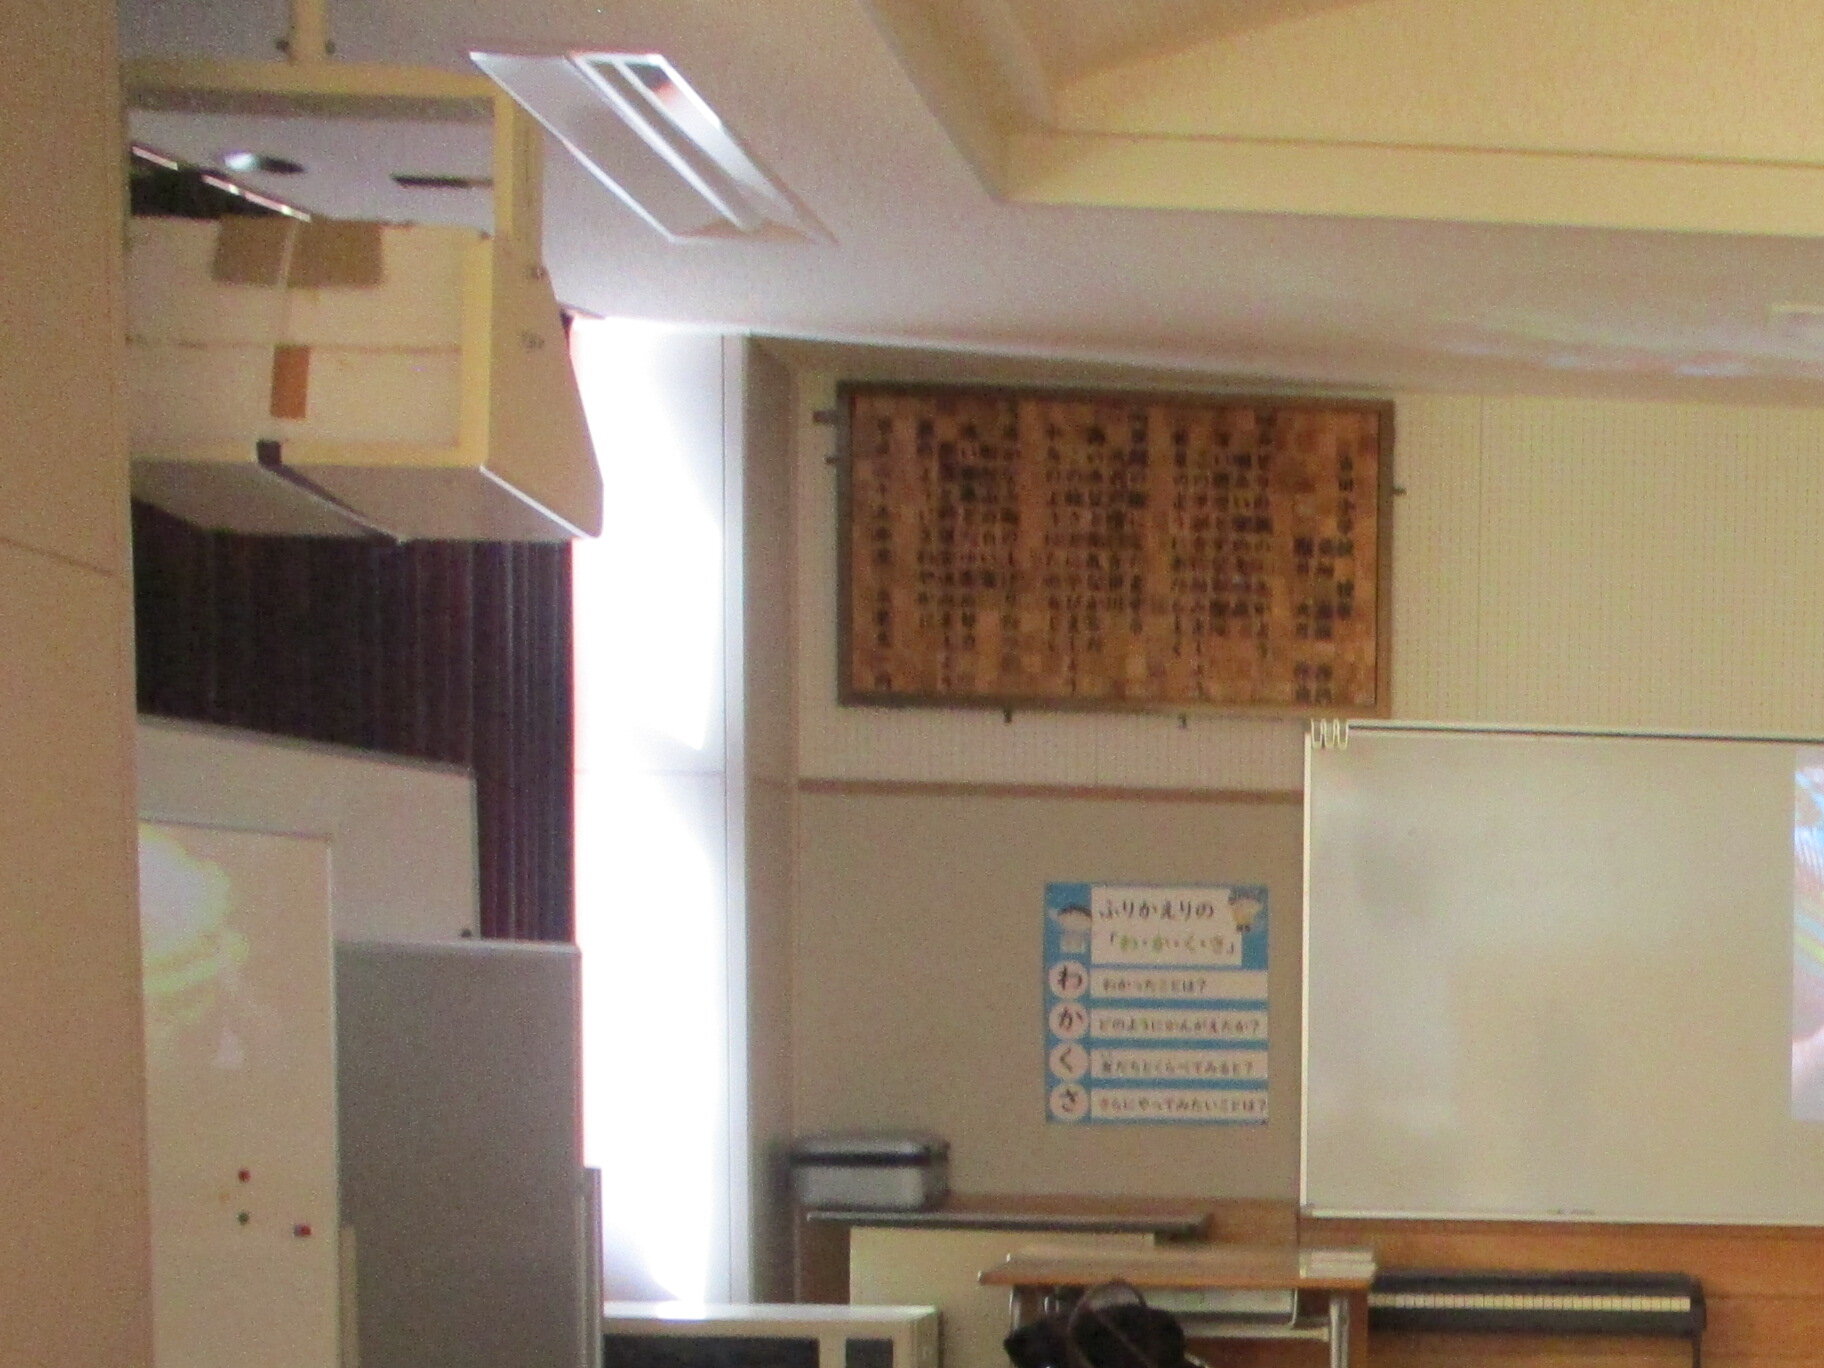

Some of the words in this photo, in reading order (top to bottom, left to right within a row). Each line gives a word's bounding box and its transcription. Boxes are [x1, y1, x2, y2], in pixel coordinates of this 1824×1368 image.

[1099, 899, 1215, 921] ふりかえりの
[1057, 965, 1083, 992] わ
[1059, 1048, 1074, 1073] く
